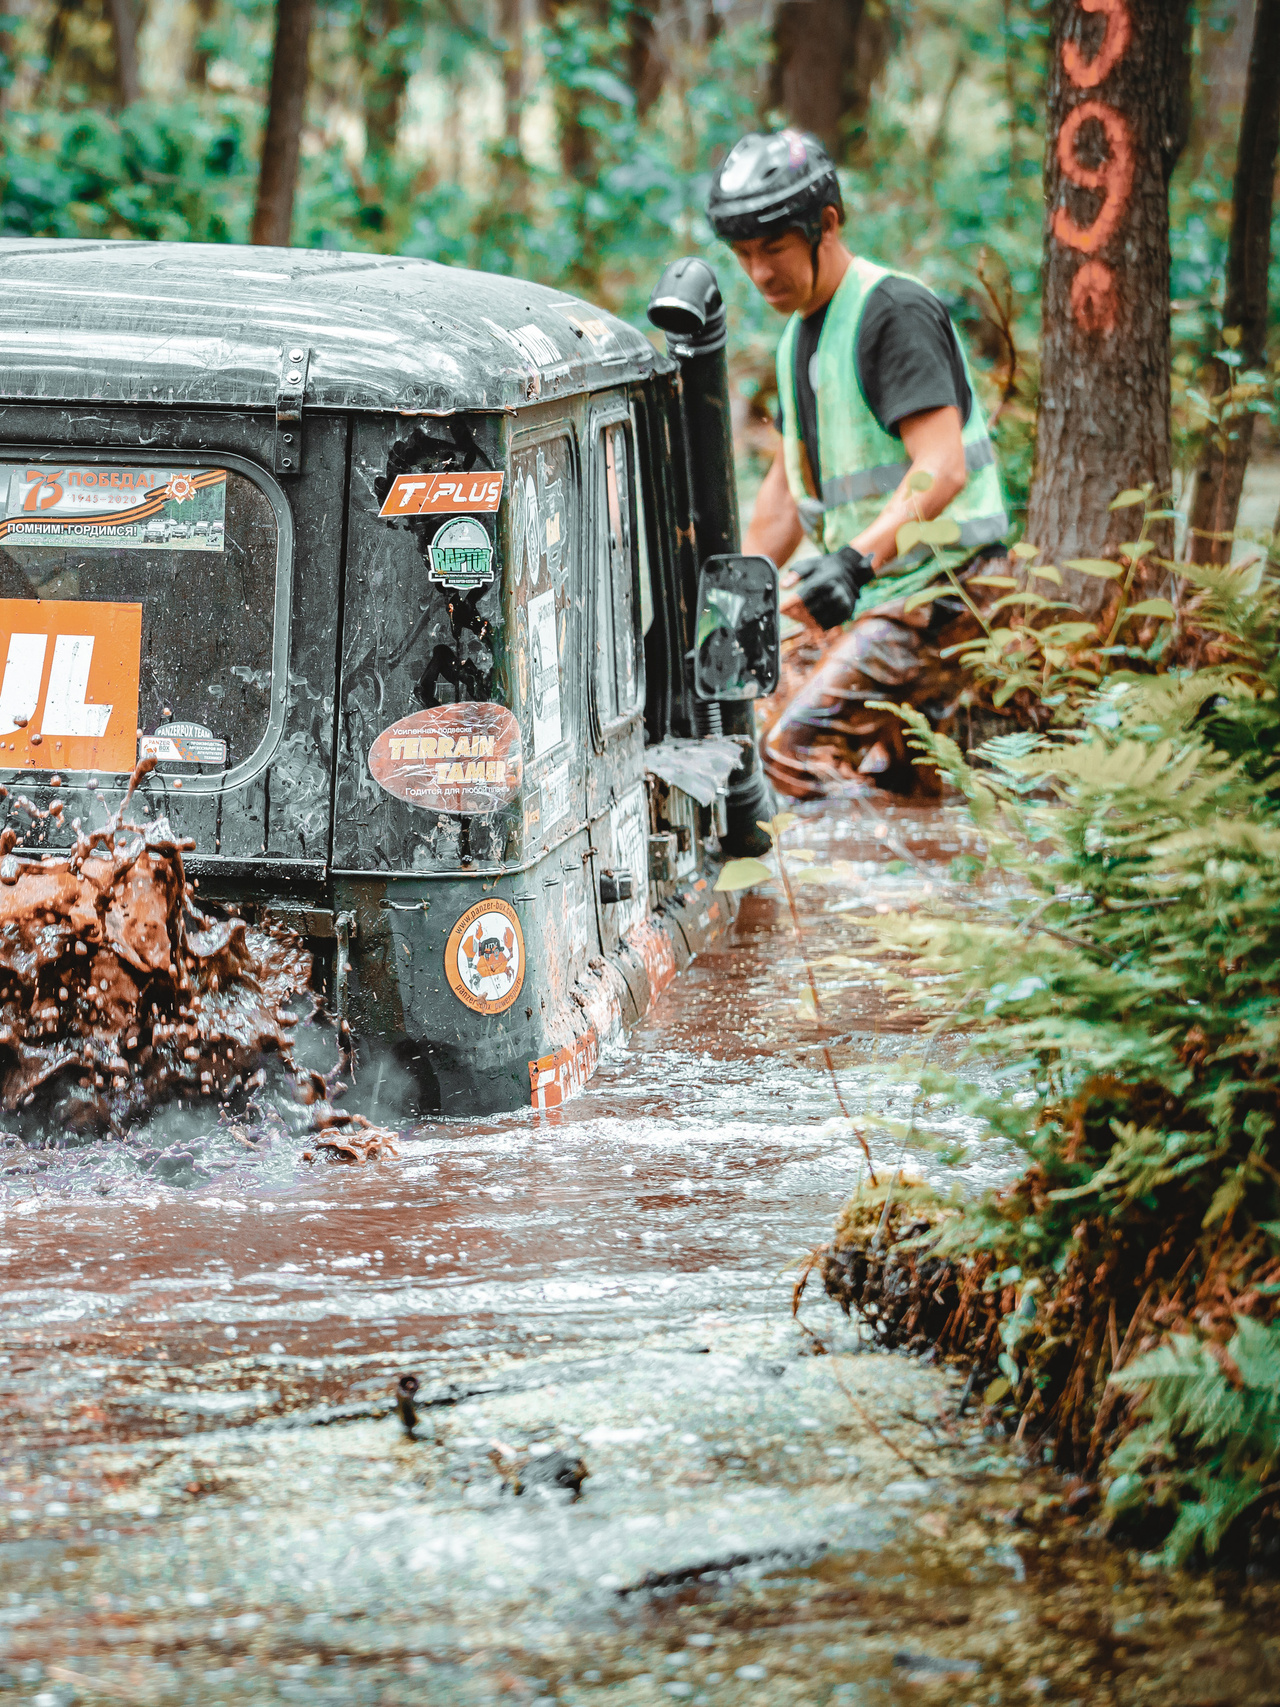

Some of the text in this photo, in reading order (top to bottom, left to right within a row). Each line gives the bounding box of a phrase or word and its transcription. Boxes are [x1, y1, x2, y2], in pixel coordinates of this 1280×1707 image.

[68, 471, 156, 491] ПОБЕДА!
[430, 481, 501, 503] PLUS
[7, 523, 137, 537] ПОМНИМ! ГОРДИМСЯ!
[432, 548, 491, 572] RAPTOR
[157, 724, 210, 738] PANZERBOX TEAM
[388, 735, 496, 760] TERRAIN
[435, 760, 507, 785] TAMER
[405, 786, 443, 797] Годится
[444, 786, 460, 796] для
[455, 900, 517, 935] www.panzer-box.com
